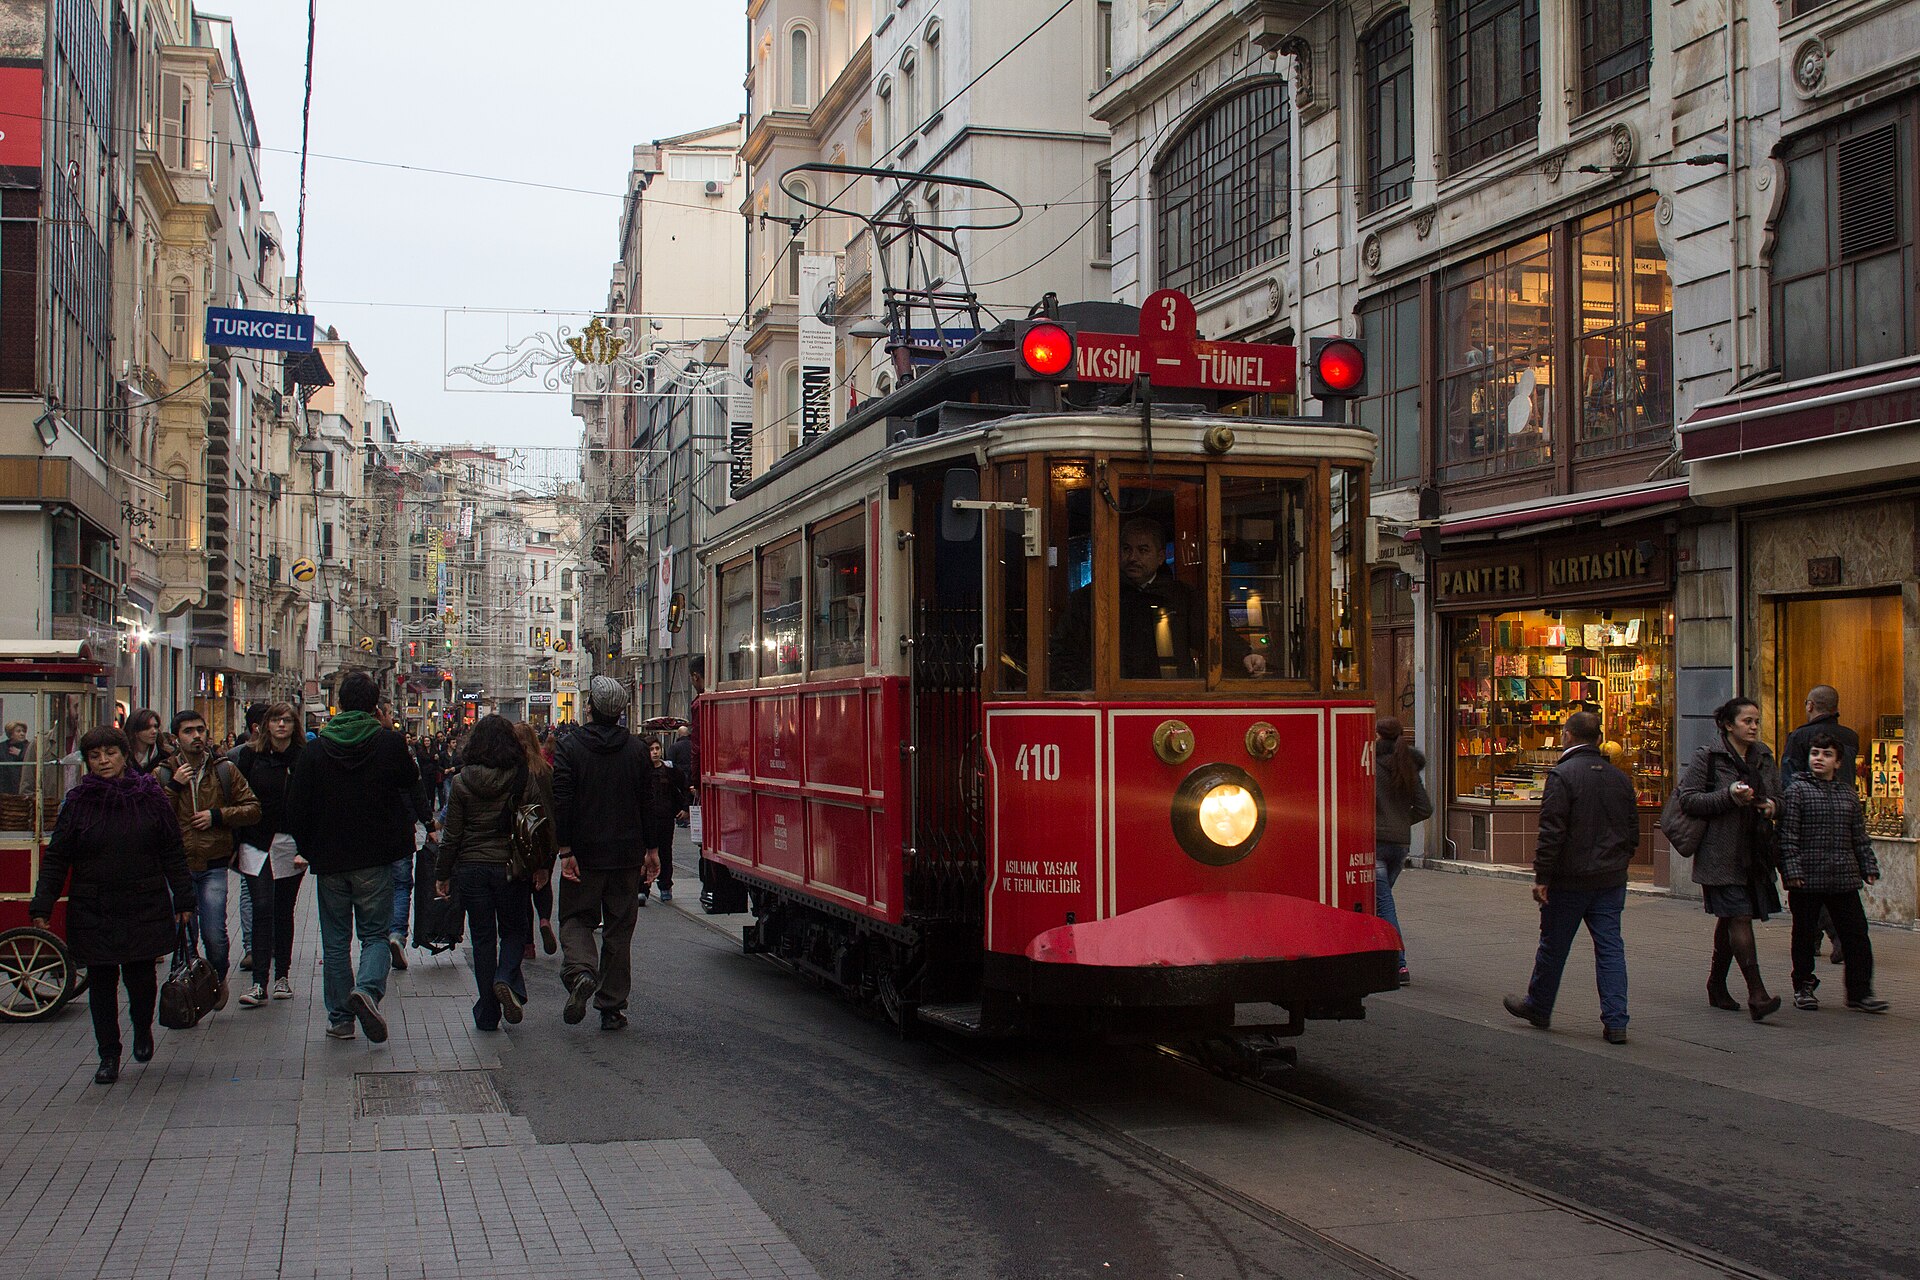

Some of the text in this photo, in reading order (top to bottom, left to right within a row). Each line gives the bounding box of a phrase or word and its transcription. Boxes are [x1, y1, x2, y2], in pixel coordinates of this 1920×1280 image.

[1161, 297, 1177, 331] 3
[212, 318, 307, 341] TURKCELL
[1077, 343, 1141, 379] AKSİM
[1197, 350, 1271, 387] TÜNEL
[1440, 544, 1646, 595] PANTER KIRTASİYE
[1015, 743, 1060, 781] 410
[1005, 860, 1078, 876] ASILMAK YASAK
[1345, 871, 1357, 884] VE
[1002, 877, 1081, 893] VE TEHLİKELİDİR
